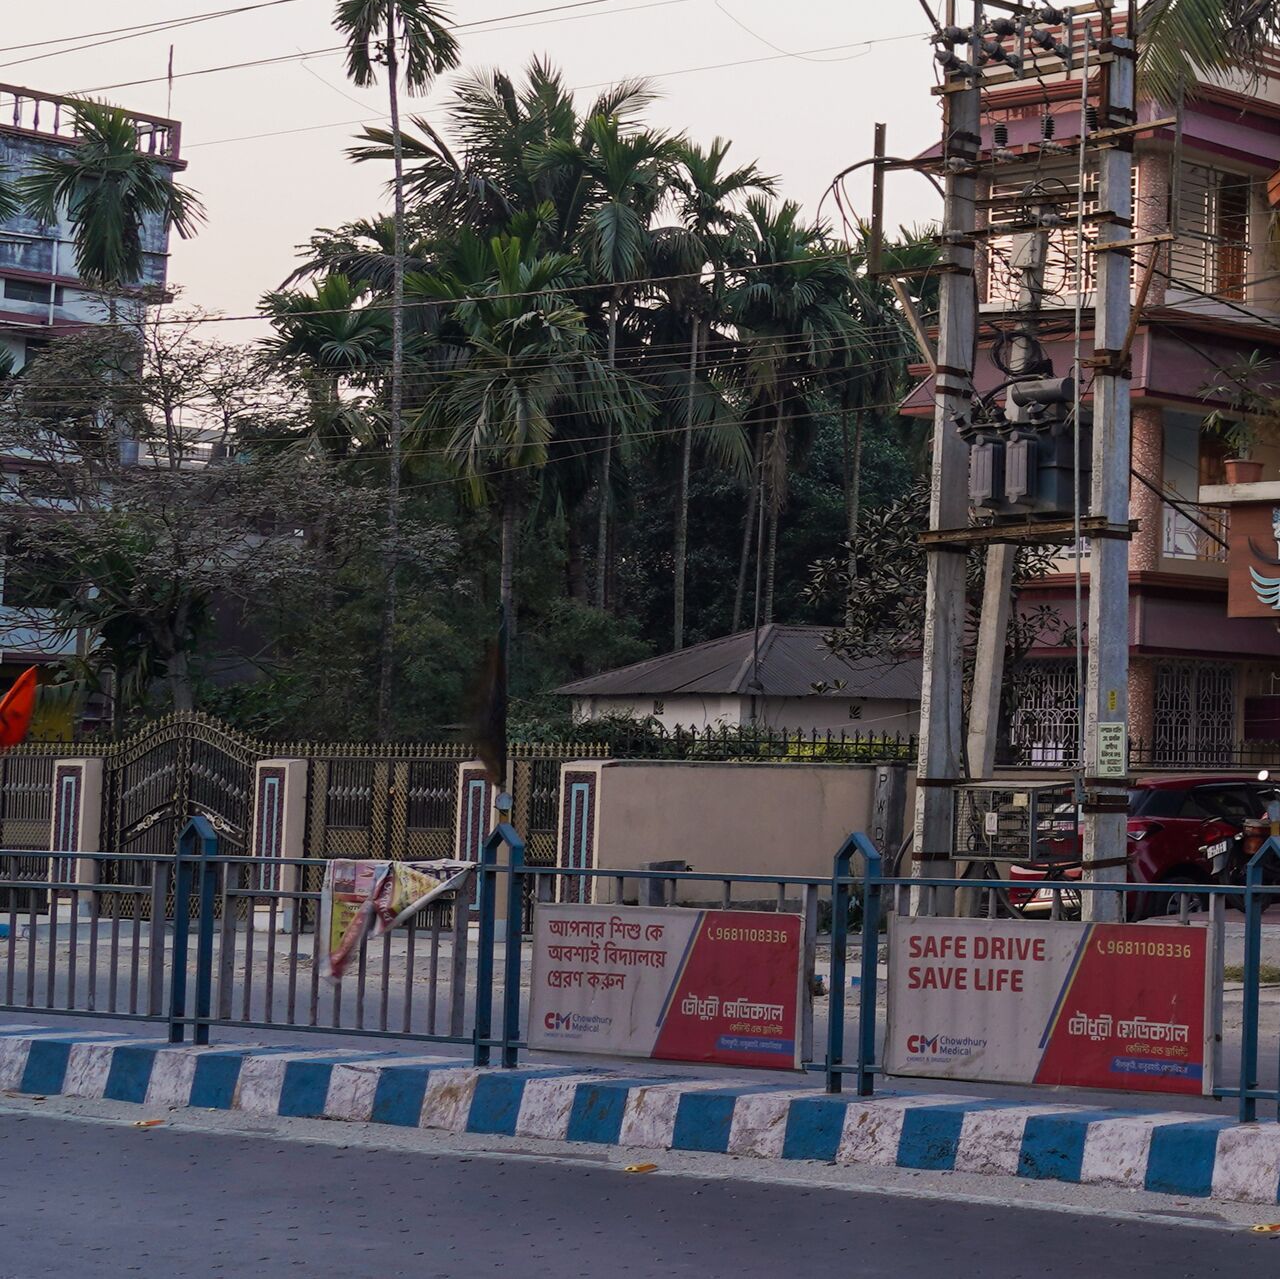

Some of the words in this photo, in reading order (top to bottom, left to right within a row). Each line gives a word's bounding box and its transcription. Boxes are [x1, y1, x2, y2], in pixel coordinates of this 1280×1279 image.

[549, 919, 605, 938] আপনার
[610, 916, 642, 941] শিশু
[645, 924, 664, 942] কে
[716, 928, 788, 944] 9681108336
[548, 941, 600, 965] অবশ্যই
[603, 942, 667, 969] বিদ্যালয়ে
[908, 935, 966, 960] SAFE
[974, 936, 1046, 962] DRIVE
[1107, 940, 1191, 959] 9681108336
[547, 970, 582, 989] প্রেরণ
[587, 971, 626, 990] করুন
[908, 966, 967, 991] SAVE
[974, 968, 1024, 993] LIFE
[681, 993, 720, 1021] চৌধুরী
[722, 997, 784, 1022] মেডিক্যাল
[572, 1013, 612, 1027] Chowdhury
[572, 1023, 600, 1033] Medical
[1068, 1010, 1112, 1041] চৌধুরী
[1116, 1016, 1189, 1044] মেডিক্যাল
[939, 1035, 987, 1049] Chowdhury
[939, 1045, 972, 1056] Medical
